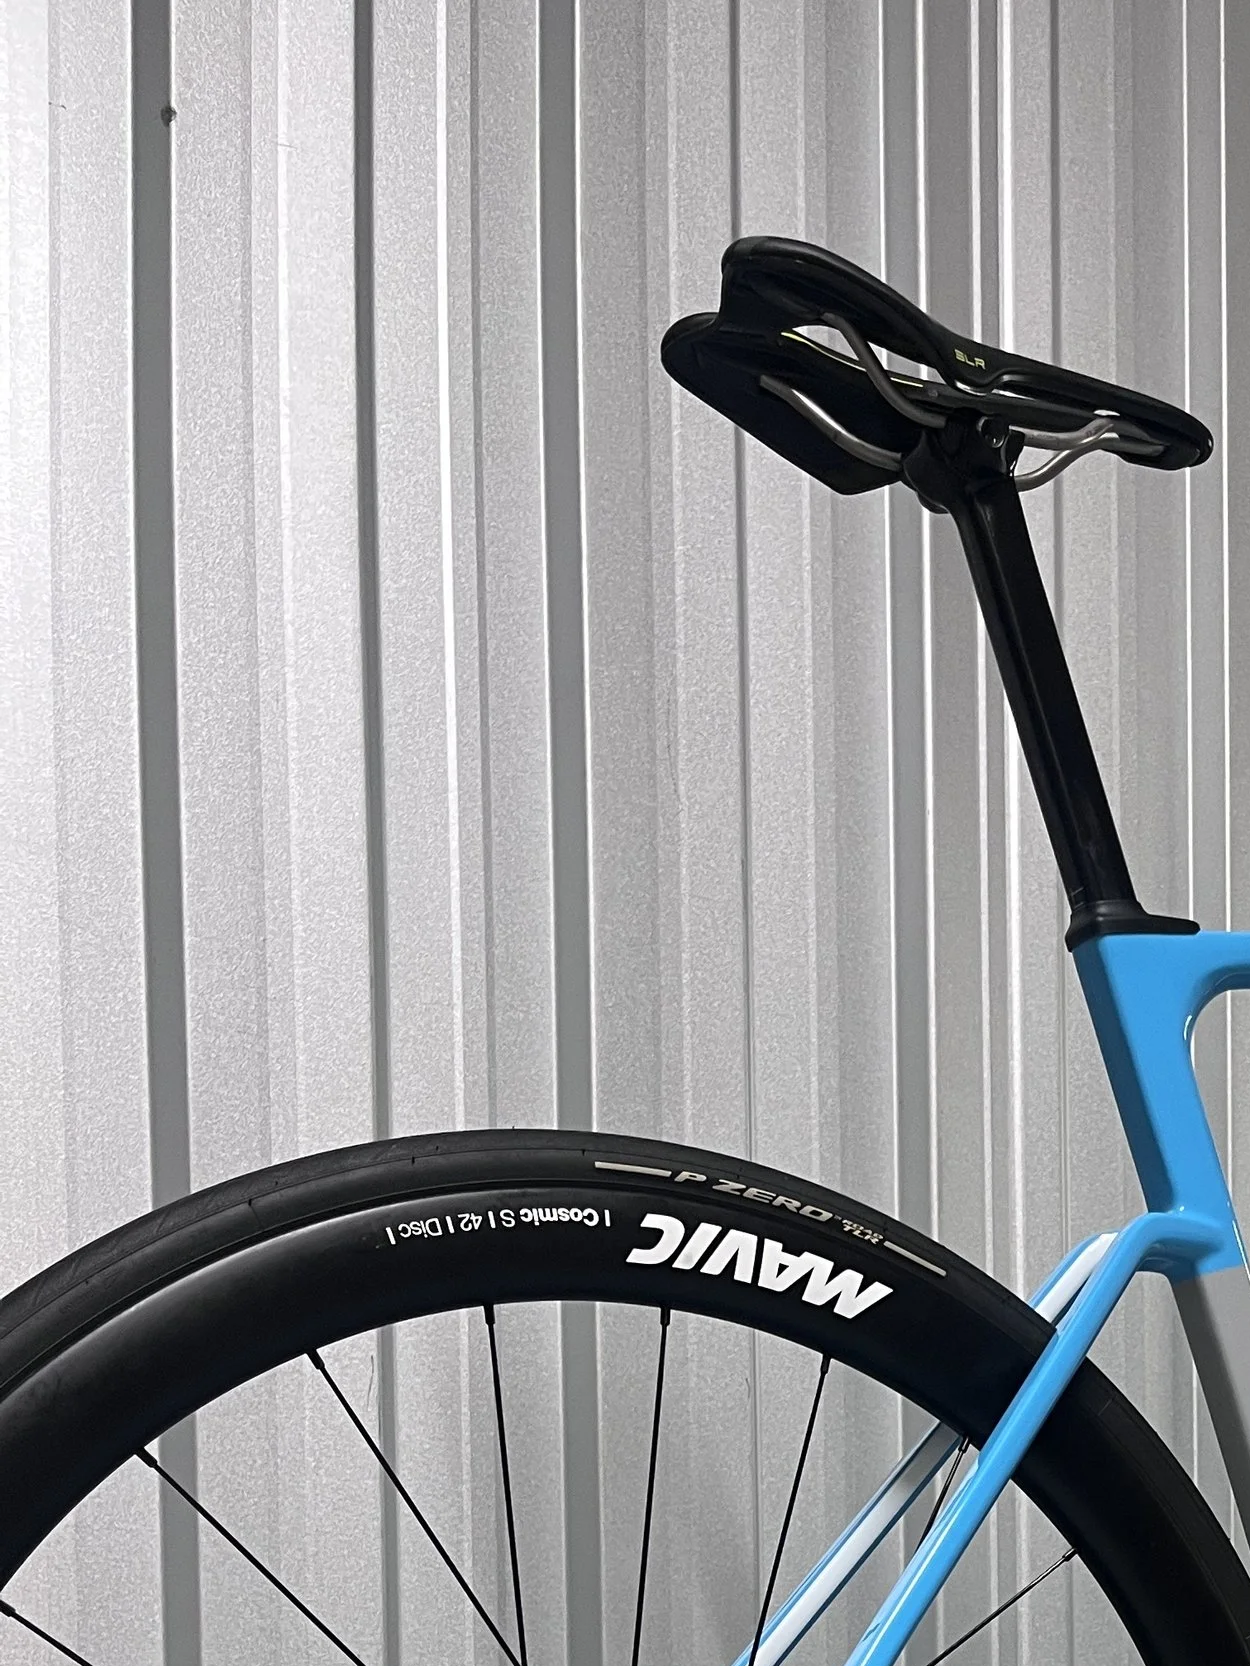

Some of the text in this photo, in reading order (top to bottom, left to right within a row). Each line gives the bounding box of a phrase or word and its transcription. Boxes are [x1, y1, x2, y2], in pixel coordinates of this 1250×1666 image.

[954, 348, 986, 370] SLR
[674, 1170, 834, 1222] P ZERO
[397, 1207, 600, 1239] Cosmic S 42 Disc
[625, 1213, 894, 1319] MAVIC
